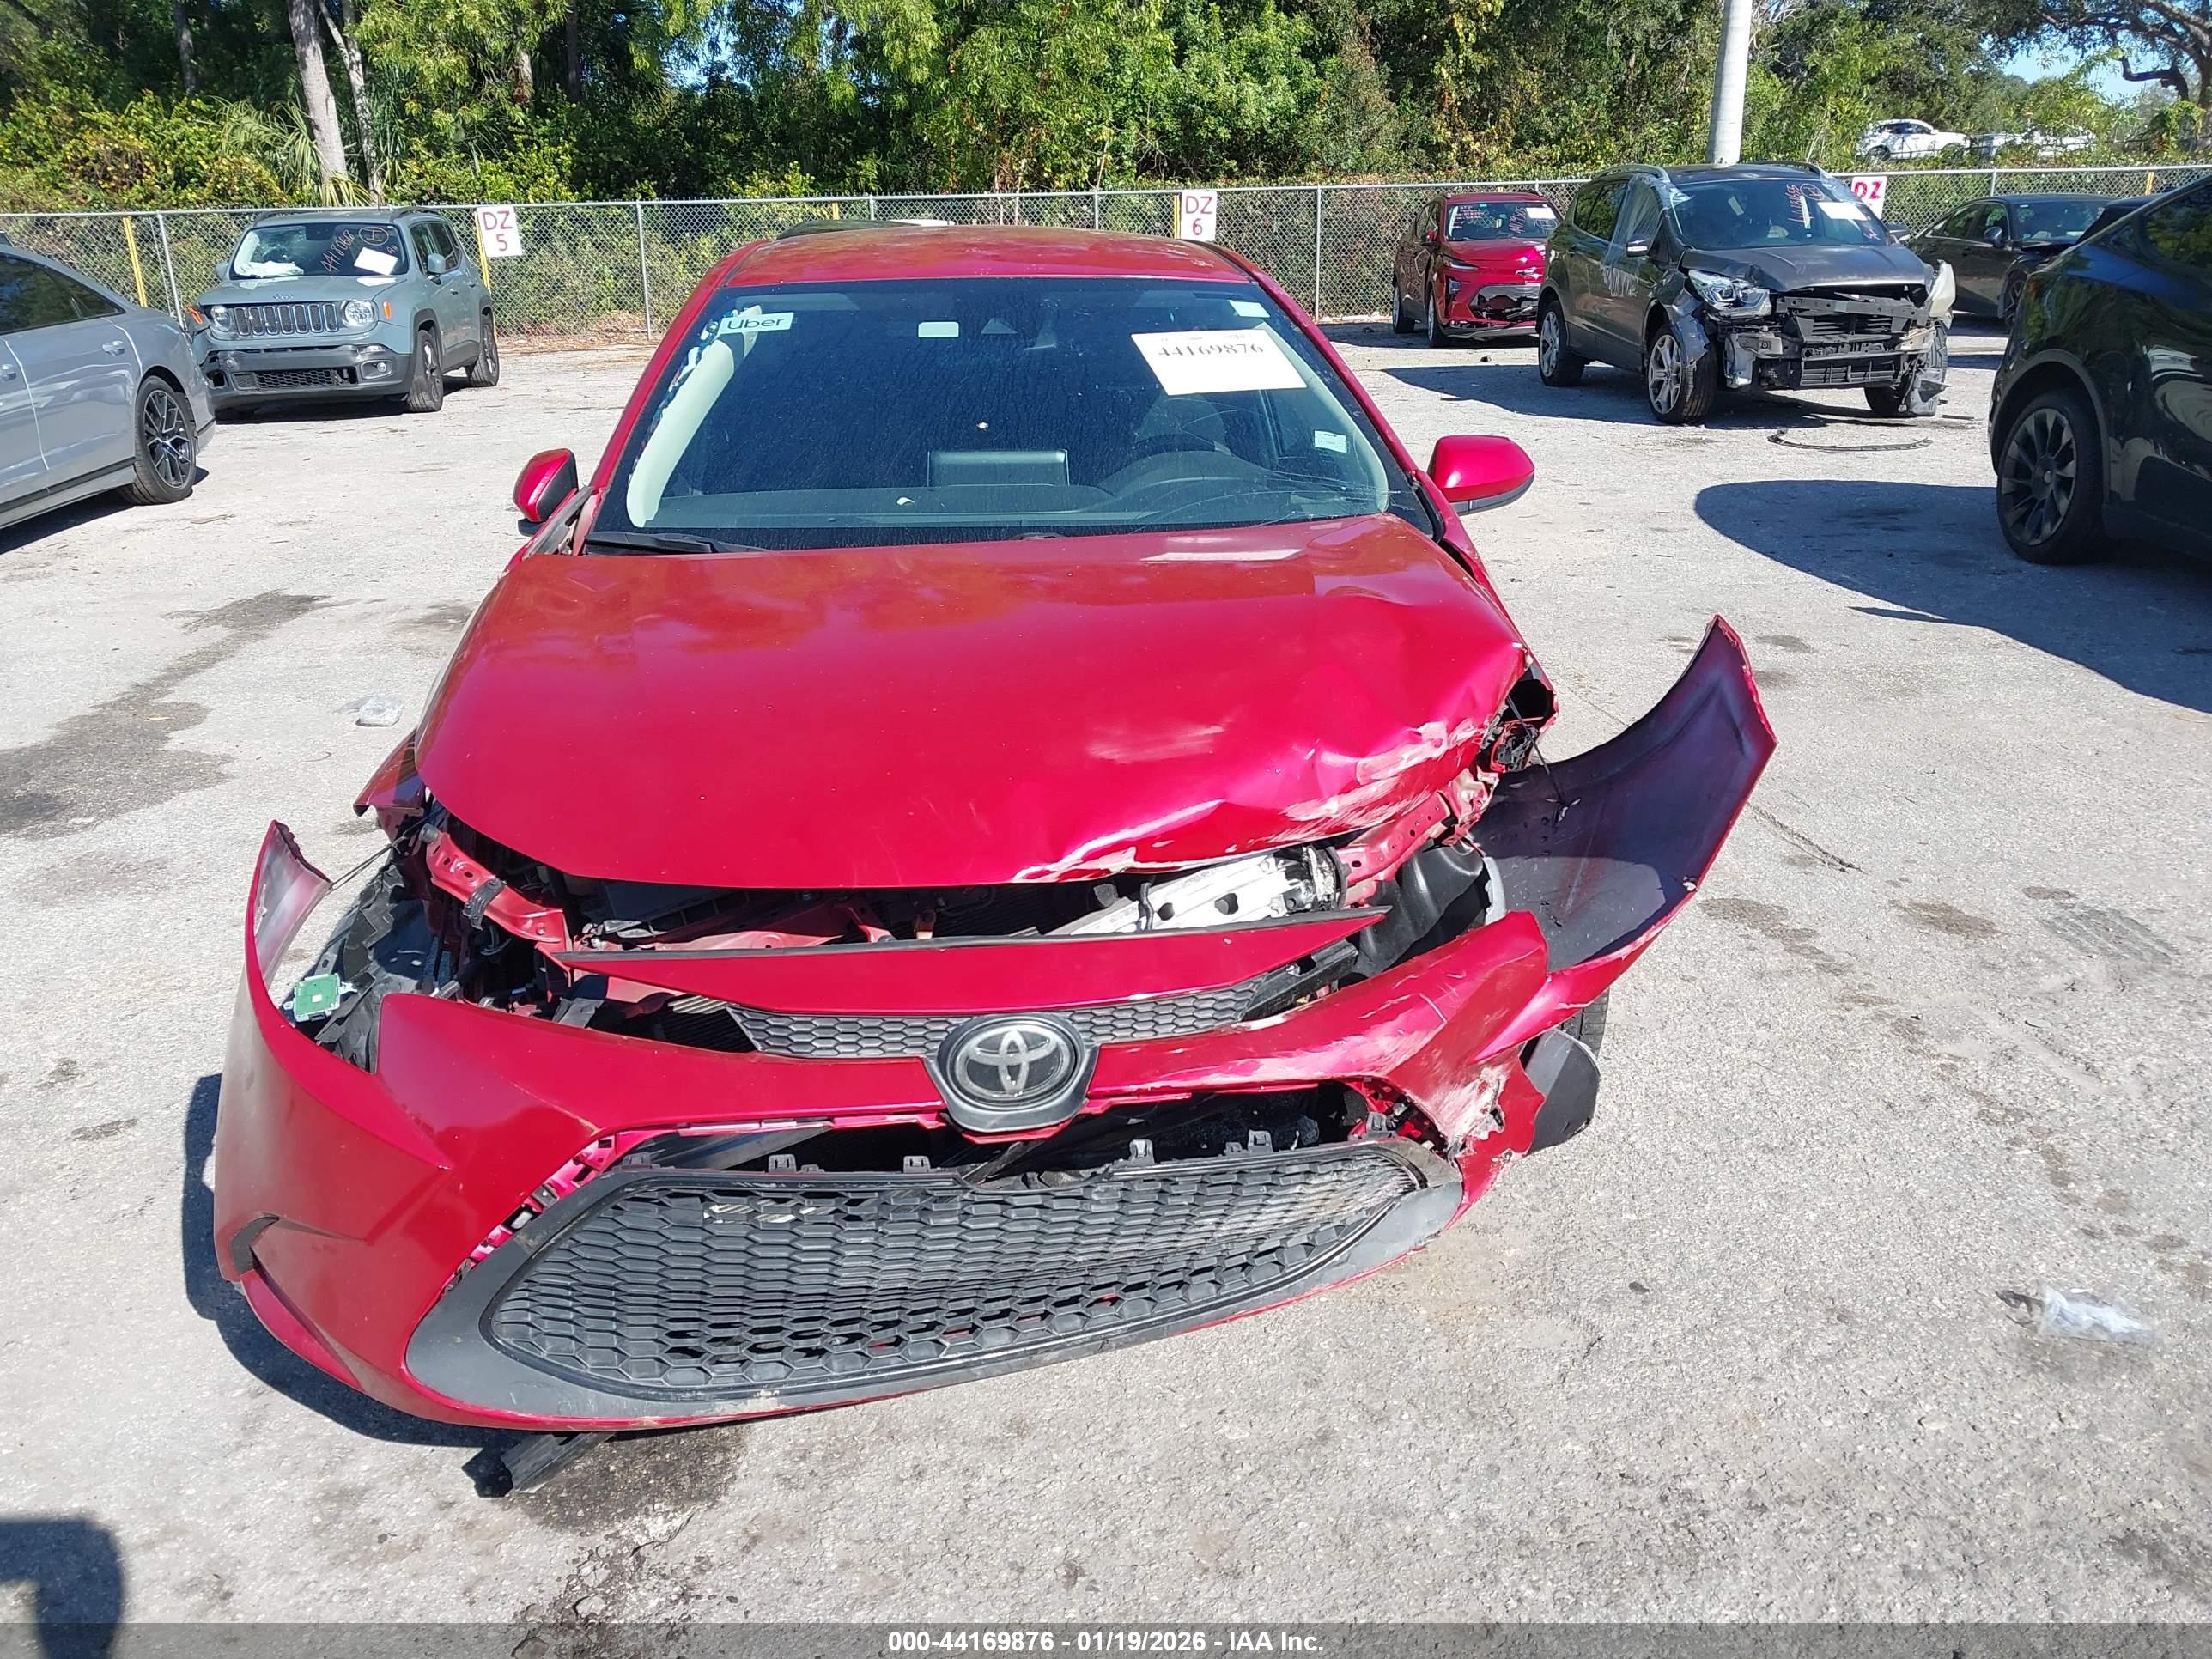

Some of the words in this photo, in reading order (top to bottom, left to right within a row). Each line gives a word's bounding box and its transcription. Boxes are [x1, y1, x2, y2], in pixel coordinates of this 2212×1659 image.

[1854, 181, 1882, 199] DZ
[1186, 196, 1212, 214] DZ
[482, 210, 513, 230] DZ
[1193, 218, 1202, 236] 6
[496, 234, 507, 252] 5
[727, 318, 785, 330] Uber
[1158, 343, 1264, 357] 44169876
